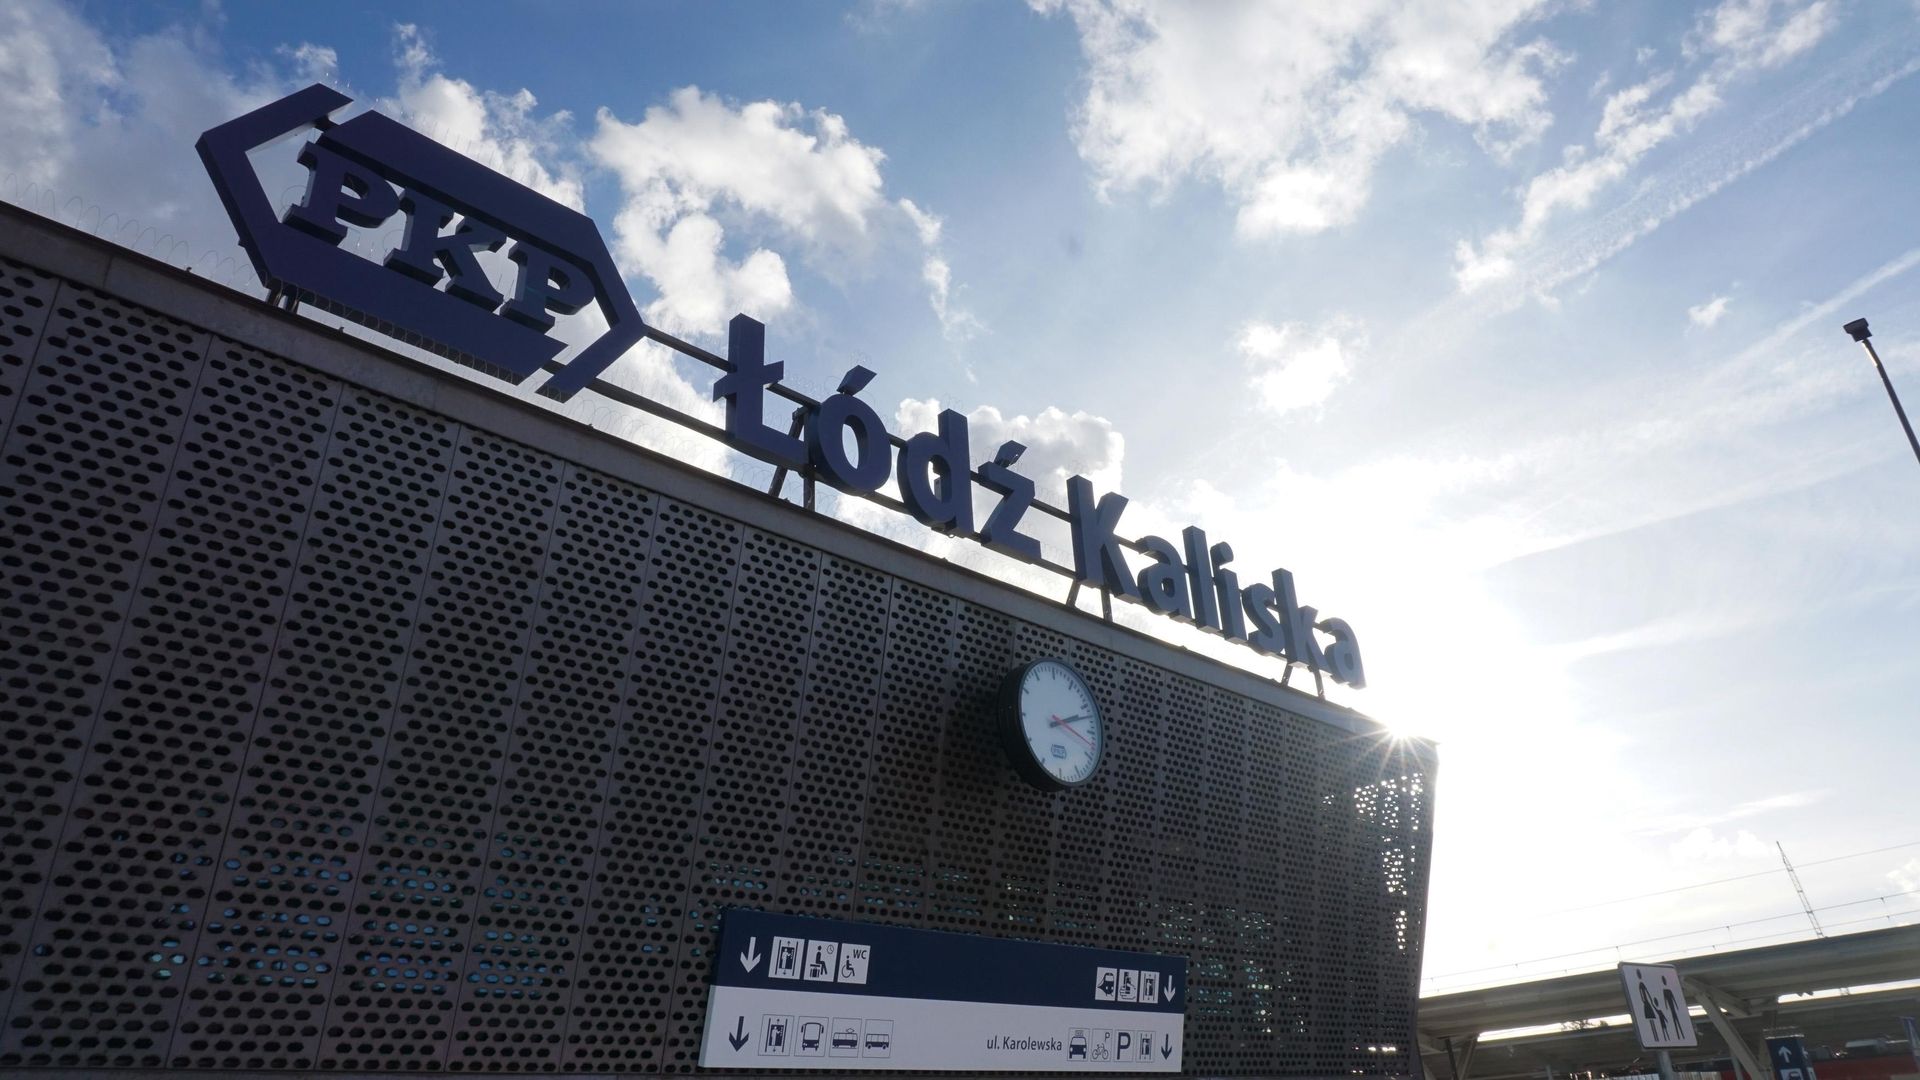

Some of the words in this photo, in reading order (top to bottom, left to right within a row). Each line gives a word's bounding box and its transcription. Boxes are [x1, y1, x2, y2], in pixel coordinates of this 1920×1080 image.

[282, 140, 596, 334] PKP
[713, 313, 1041, 564] Łódź
[1066, 474, 1367, 690] Kaliska
[852, 948, 867, 960] WC
[986, 1035, 1000, 1050] ul.
[1003, 1035, 1062, 1051] Karolewska
[1104, 1032, 1110, 1042] P
[1116, 1032, 1131, 1060] P
